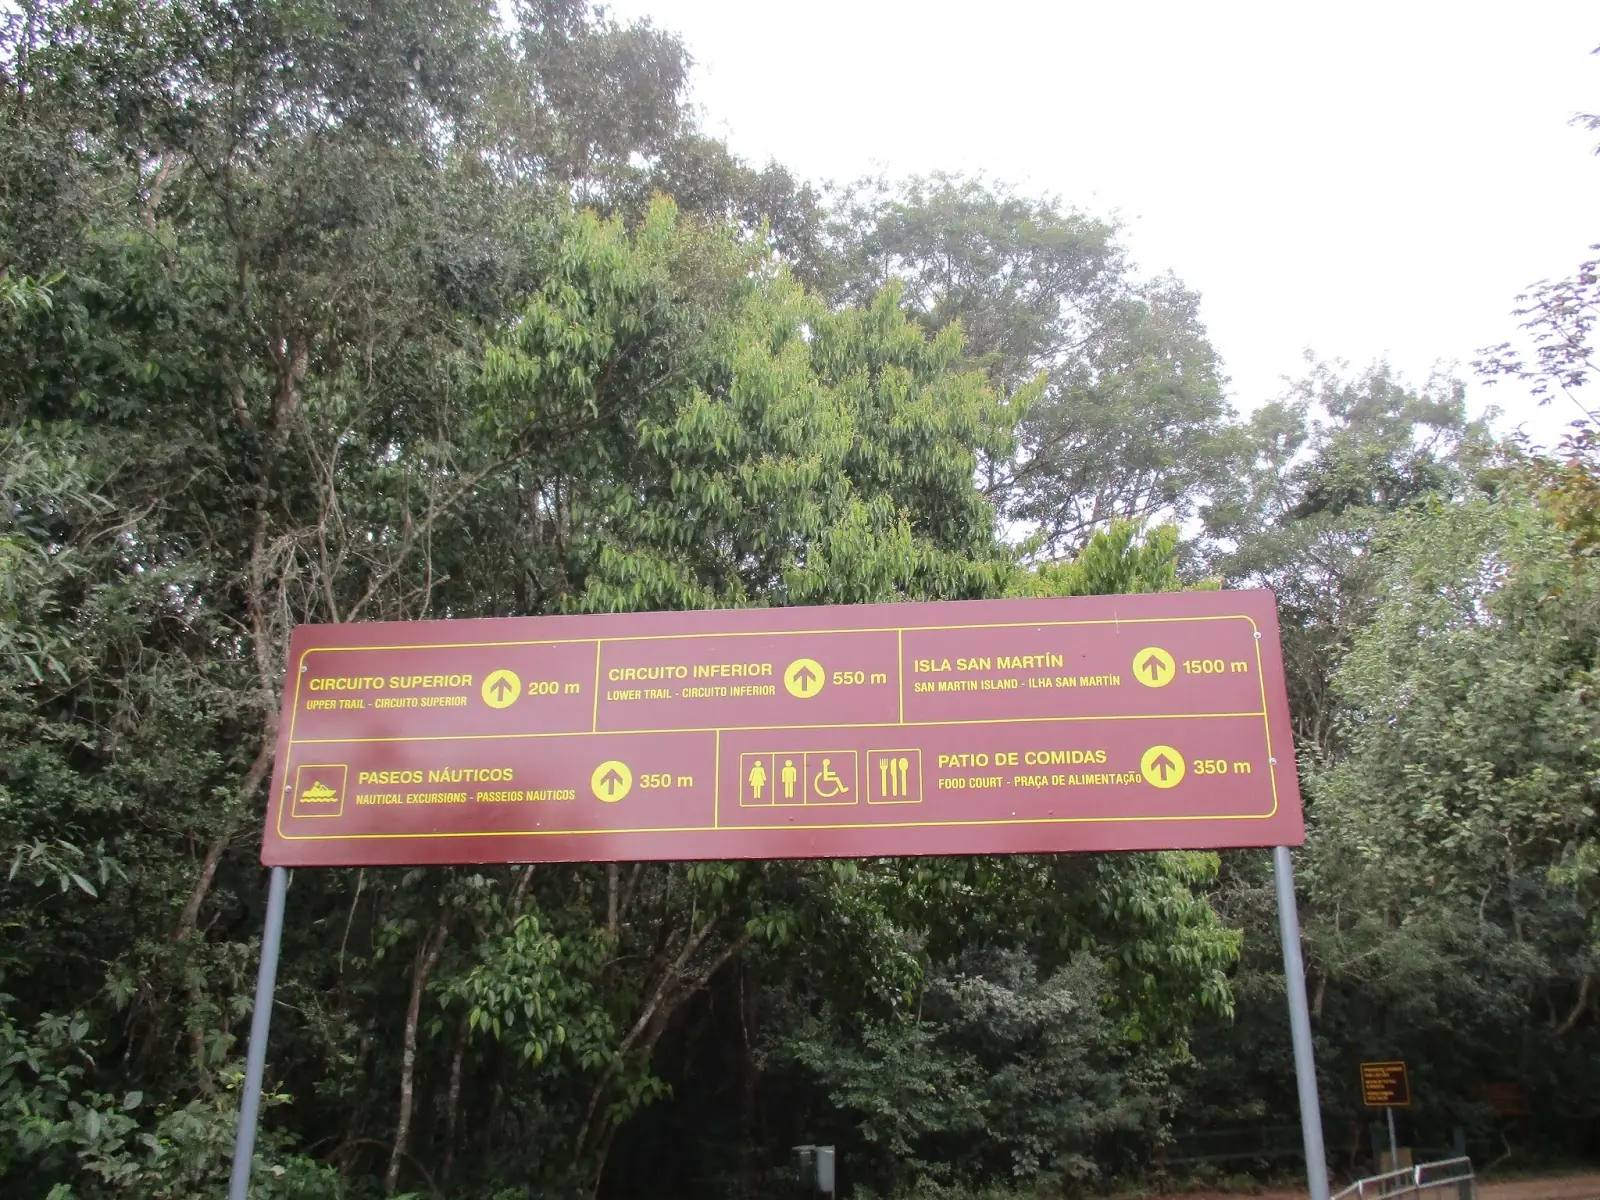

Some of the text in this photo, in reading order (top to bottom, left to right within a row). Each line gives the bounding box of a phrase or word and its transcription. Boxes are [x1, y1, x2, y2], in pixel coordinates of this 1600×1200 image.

[913, 653, 1064, 672] ISLA SAN MARTÍN
[1183, 659, 1249, 674] 1500 m
[608, 663, 773, 681] CIRCUITO INFERIOR
[832, 672, 888, 685] 550 m
[308, 674, 473, 692] CIRCUITO SUPERIOR
[528, 681, 581, 696] 200 m
[914, 682, 936, 693] SAN
[938, 680, 979, 692] MARTIN
[981, 679, 1019, 690] ISLAND
[1028, 677, 1054, 688] ILHA
[1055, 676, 1078, 687] SAN
[1079, 674, 1122, 686] MARTÍN
[607, 689, 642, 701] LOWER
[643, 688, 672, 699] TRAIL
[682, 687, 727, 698] CIRCUITO
[729, 685, 777, 697] INFERIOR
[306, 698, 337, 710] UPPER
[339, 698, 366, 709] TRAIL
[374, 697, 419, 708] CIRCUITO
[420, 696, 468, 707] SUPERIOR
[937, 749, 1108, 768] PATIO DE COMIDAS
[1193, 759, 1252, 775] 350 m
[358, 767, 514, 785] PASEOS NÁUTICOS
[640, 774, 694, 788] 350 m
[938, 777, 969, 789] FOOD
[971, 776, 1003, 788] COURT
[1013, 775, 1049, 789] PRAÇA
[1051, 774, 1066, 786] DE
[1068, 771, 1142, 787] ALIMENTAÇÃO
[355, 792, 404, 805] NAUTICAL
[406, 791, 468, 804] EXCURSIONS
[476, 790, 524, 803] PASSEIOS
[526, 789, 577, 801] NAUTICOS
